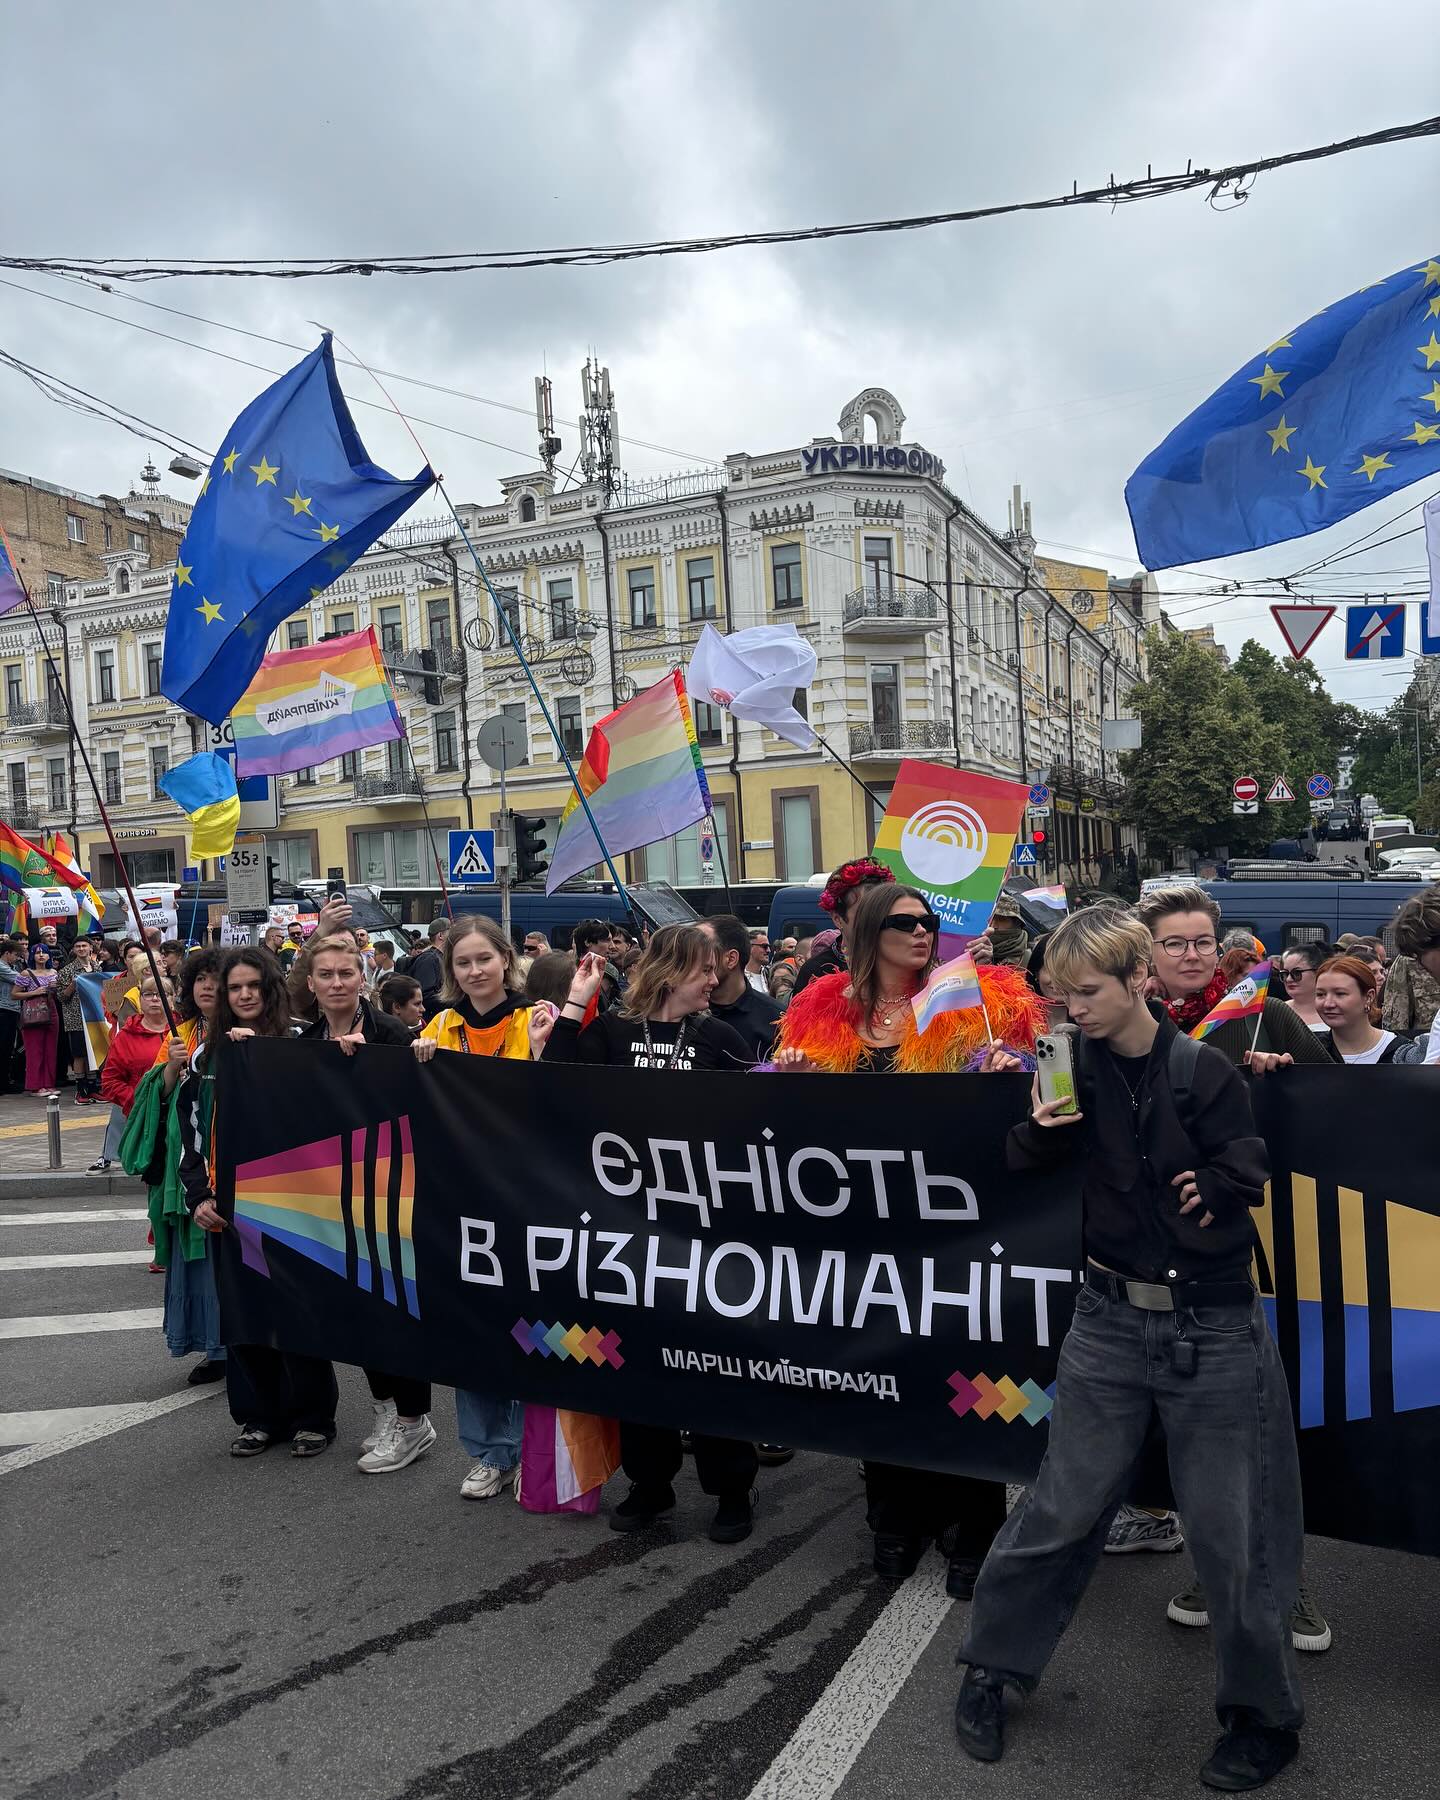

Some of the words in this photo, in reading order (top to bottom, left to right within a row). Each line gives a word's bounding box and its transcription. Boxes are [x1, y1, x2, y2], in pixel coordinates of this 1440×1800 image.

[460, 1216, 505, 1288] В
[662, 1347, 743, 1378] МАРШ
[748, 1357, 900, 1402] КИЇВПРАЙД
